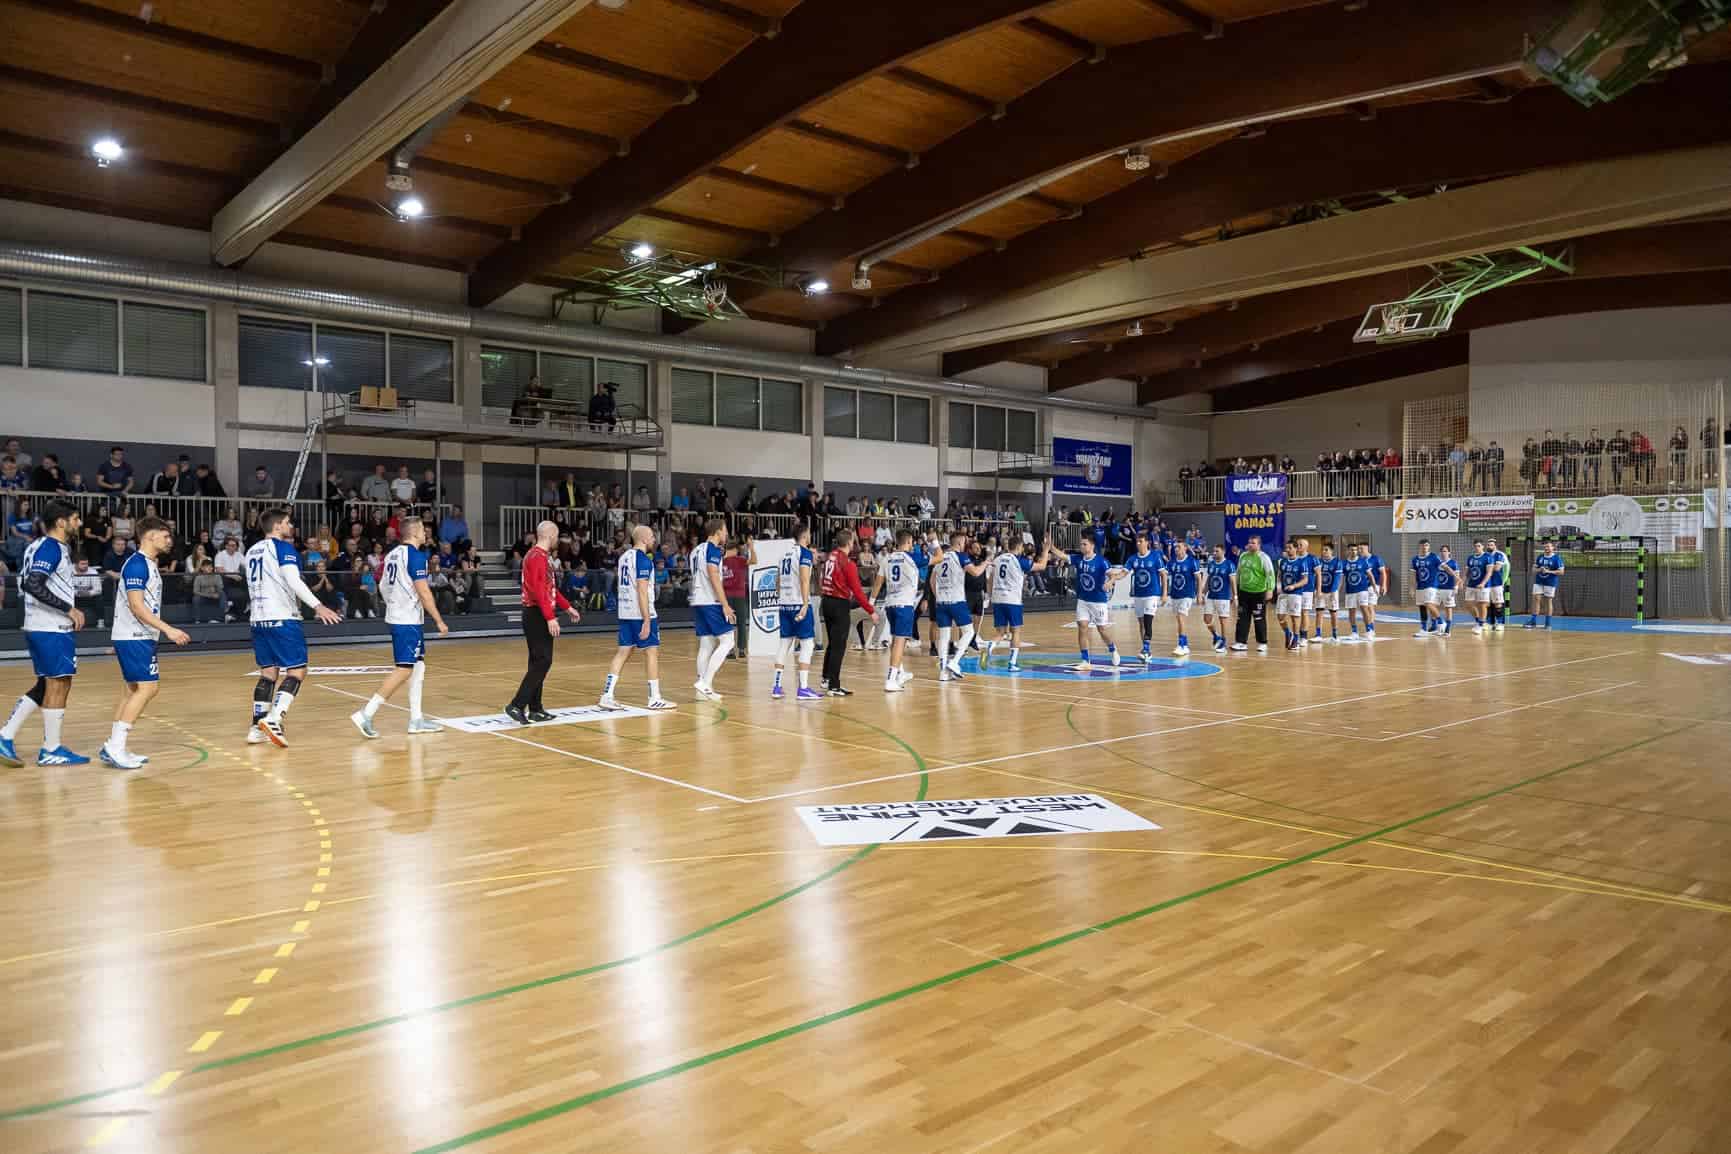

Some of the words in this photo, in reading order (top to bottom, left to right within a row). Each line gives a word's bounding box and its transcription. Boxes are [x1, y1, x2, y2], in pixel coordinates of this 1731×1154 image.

[1405, 508, 1459, 521] SAKOS
[249, 557, 263, 582] 21
[781, 558, 792, 576] 13
[892, 564, 901, 582] 9
[941, 562, 949, 578] 2
[999, 563, 1007, 579] 6
[813, 795, 1092, 813] INDUSTRIEMONT
[995, 802, 1107, 814] WEST
[817, 807, 978, 822] ALPINE
